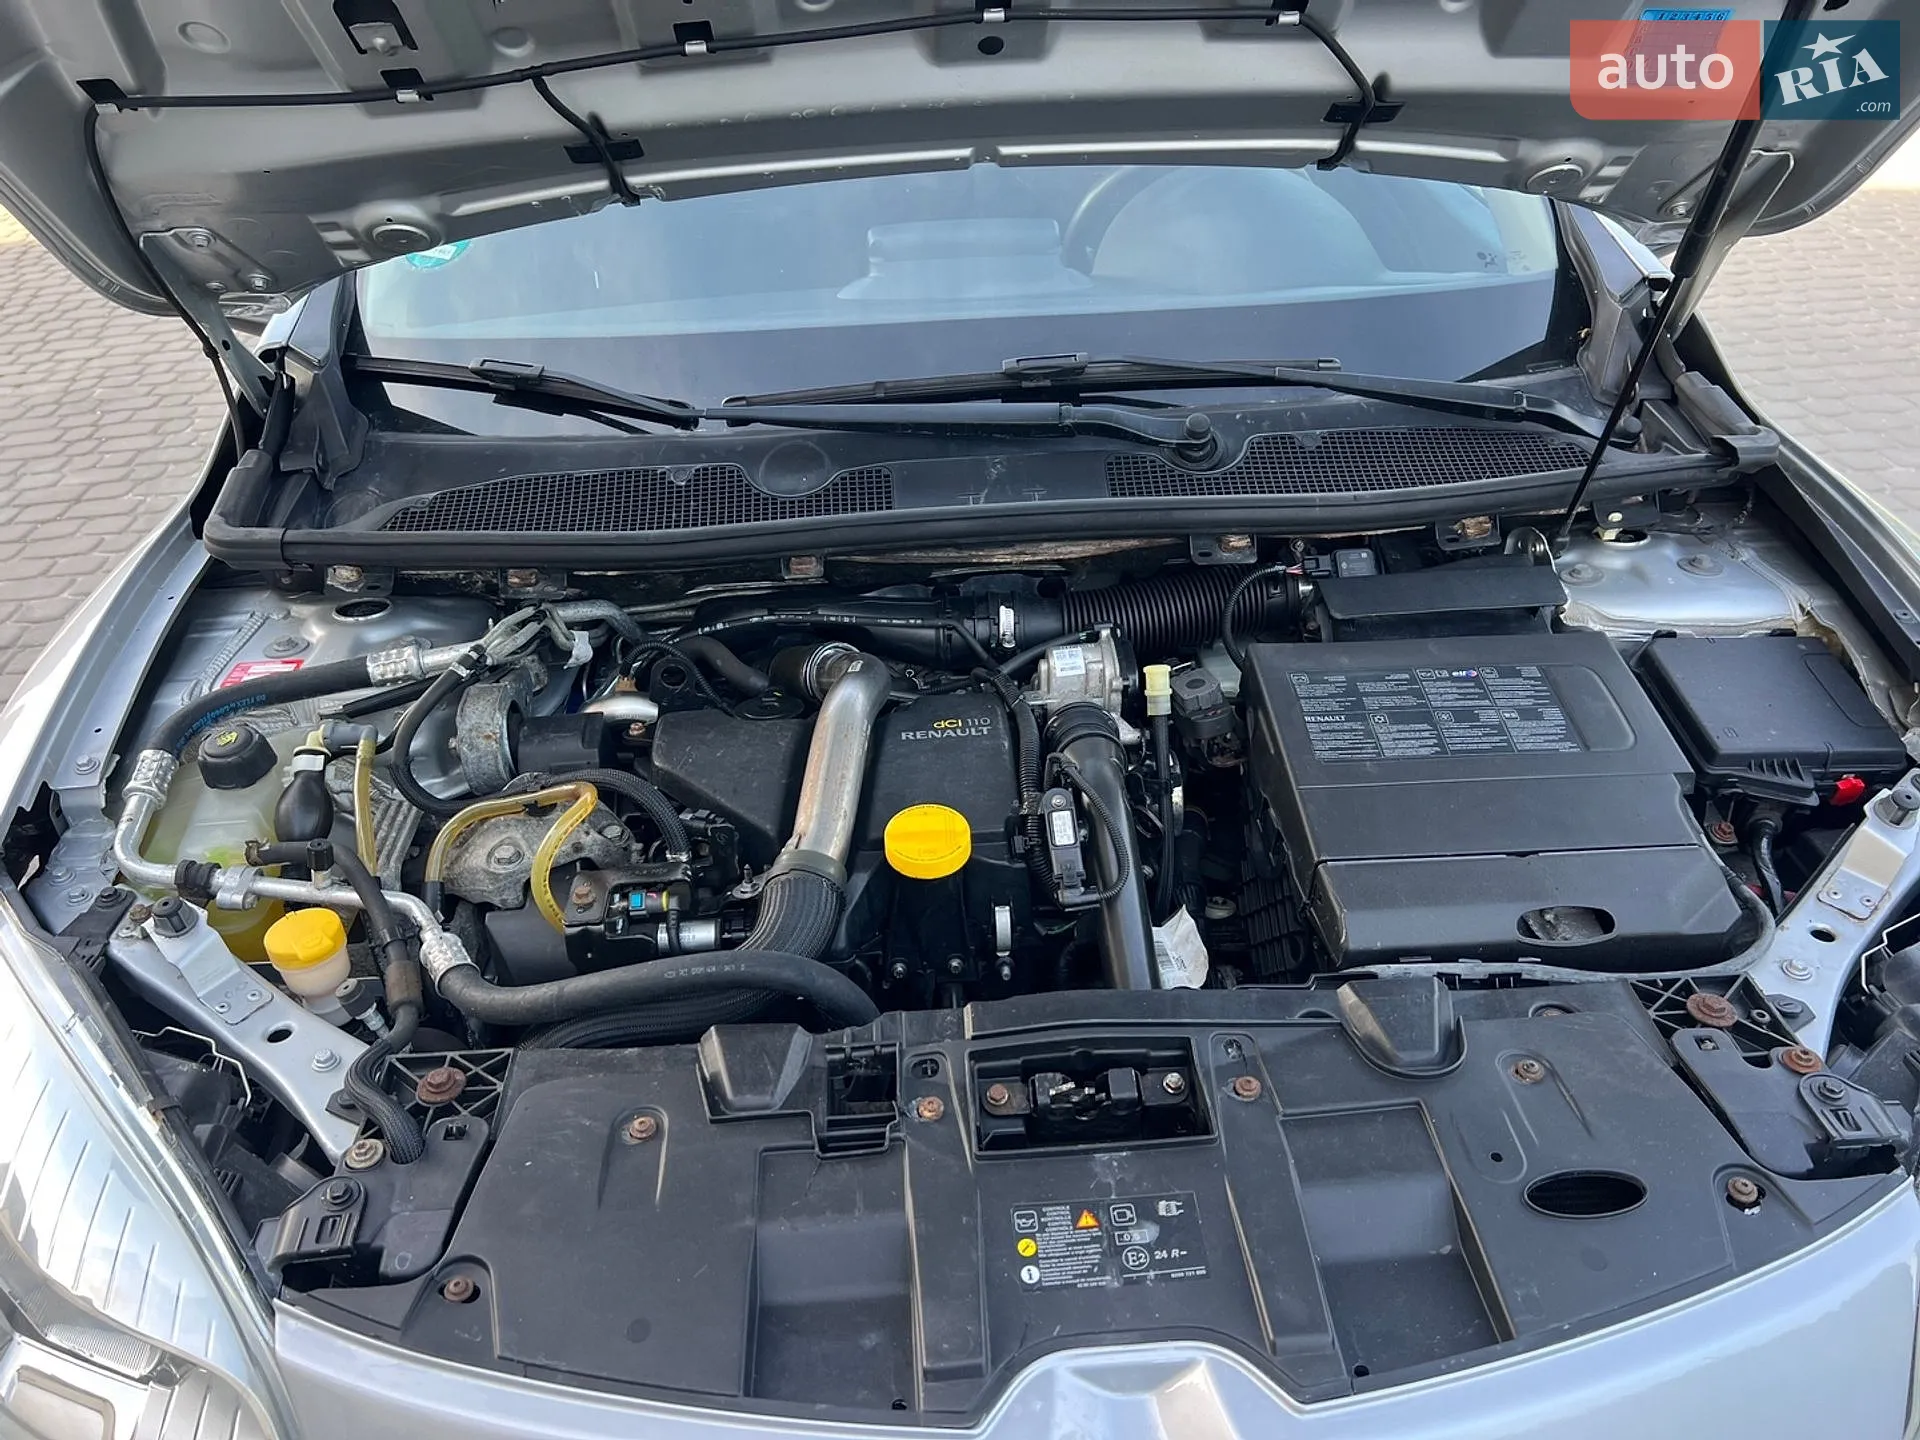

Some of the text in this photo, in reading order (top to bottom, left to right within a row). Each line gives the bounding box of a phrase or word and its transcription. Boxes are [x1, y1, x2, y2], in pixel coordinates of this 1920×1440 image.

[966, 717, 991, 726] 110
[901, 726, 992, 741] RENAULT
[1126, 1251, 1147, 1266] E2
[1154, 1249, 1168, 1260] 24
